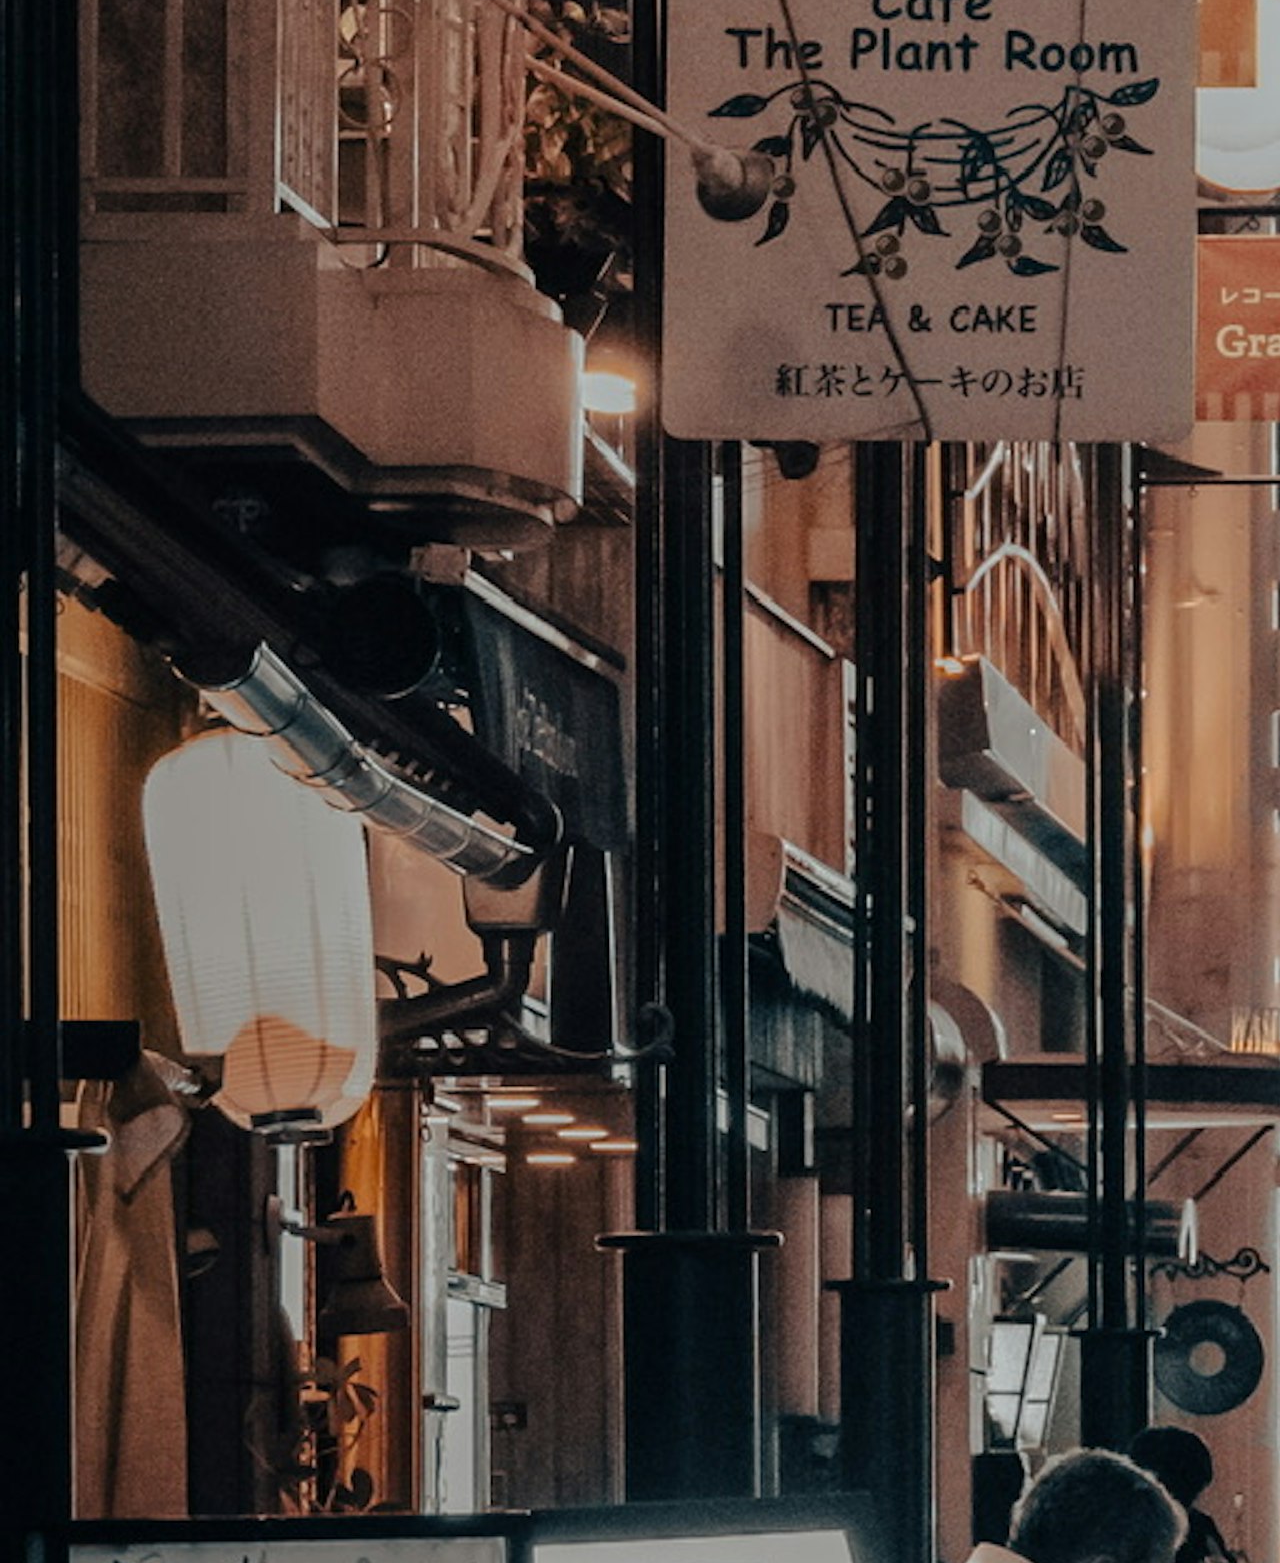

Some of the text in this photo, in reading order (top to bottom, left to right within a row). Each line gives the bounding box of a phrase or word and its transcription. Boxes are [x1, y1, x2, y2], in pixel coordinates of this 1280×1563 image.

[725, 23, 1137, 73] The Plant Room
[825, 304, 1038, 333] TEA & CAKE
[774, 362, 1085, 400] 紅茶とケーキのお店
